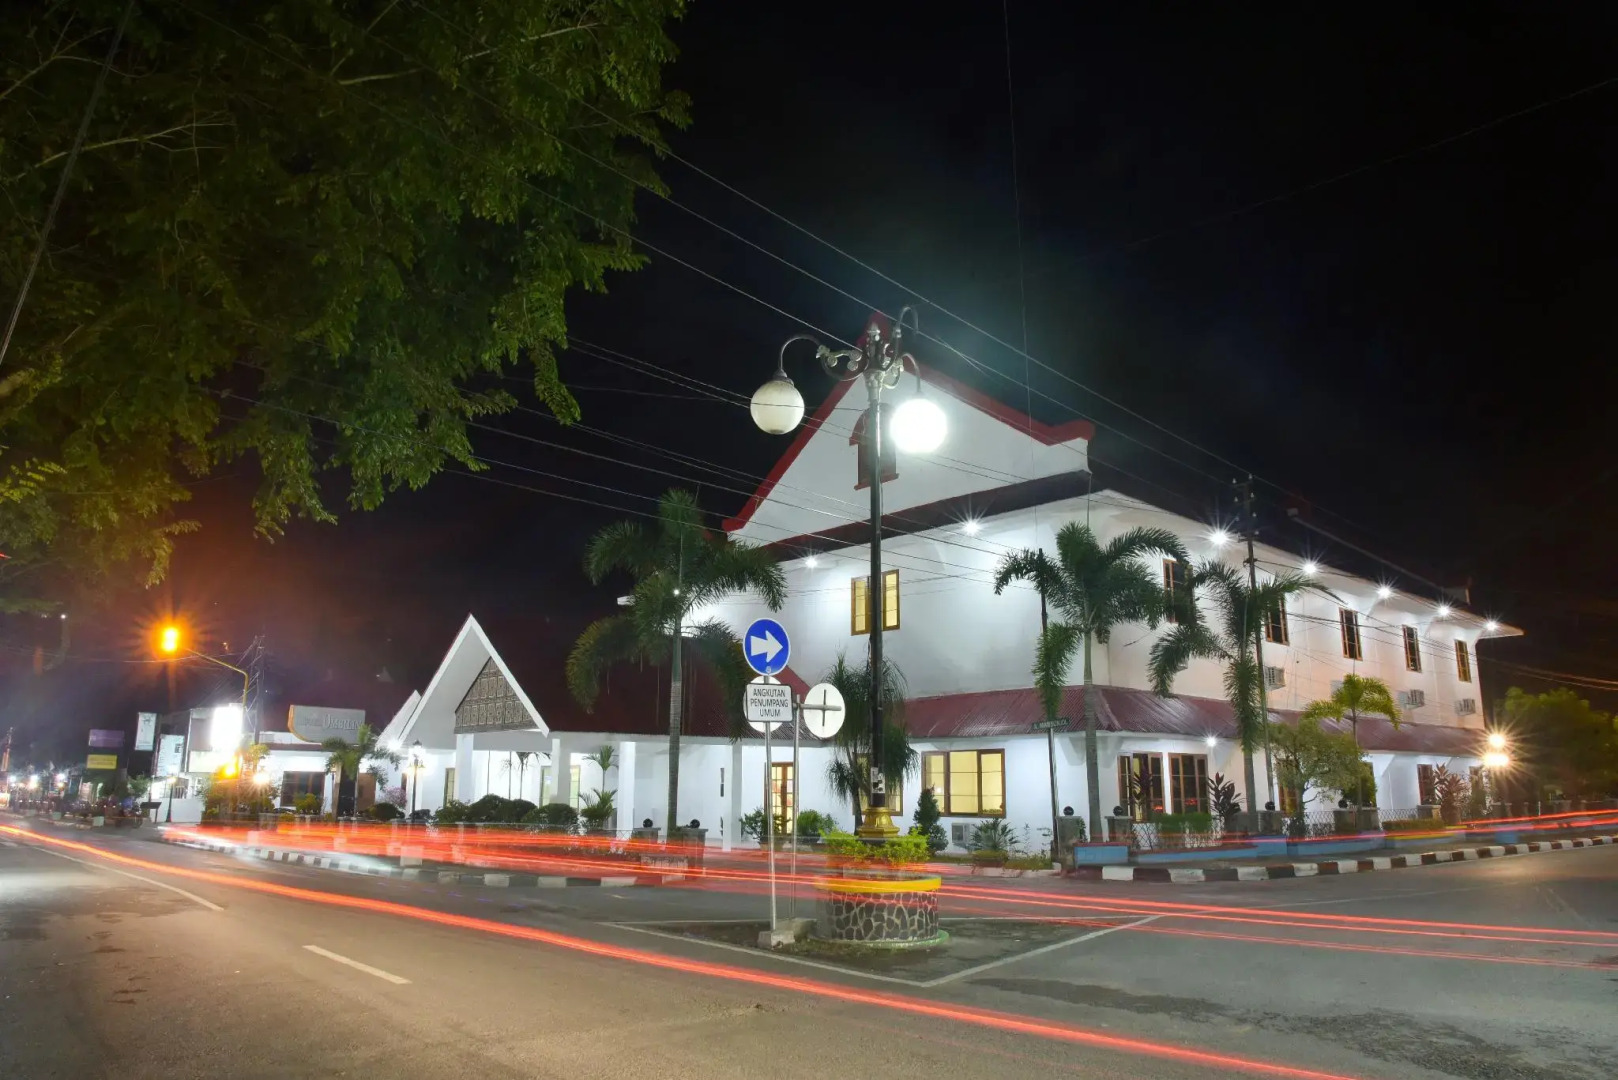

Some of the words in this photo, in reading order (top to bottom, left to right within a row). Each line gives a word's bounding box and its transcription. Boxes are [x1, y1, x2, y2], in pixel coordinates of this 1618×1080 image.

[753, 688, 785, 697] ANGKUTAN
[750, 698, 788, 707] PENUMPANG
[759, 708, 780, 717] UMUM
